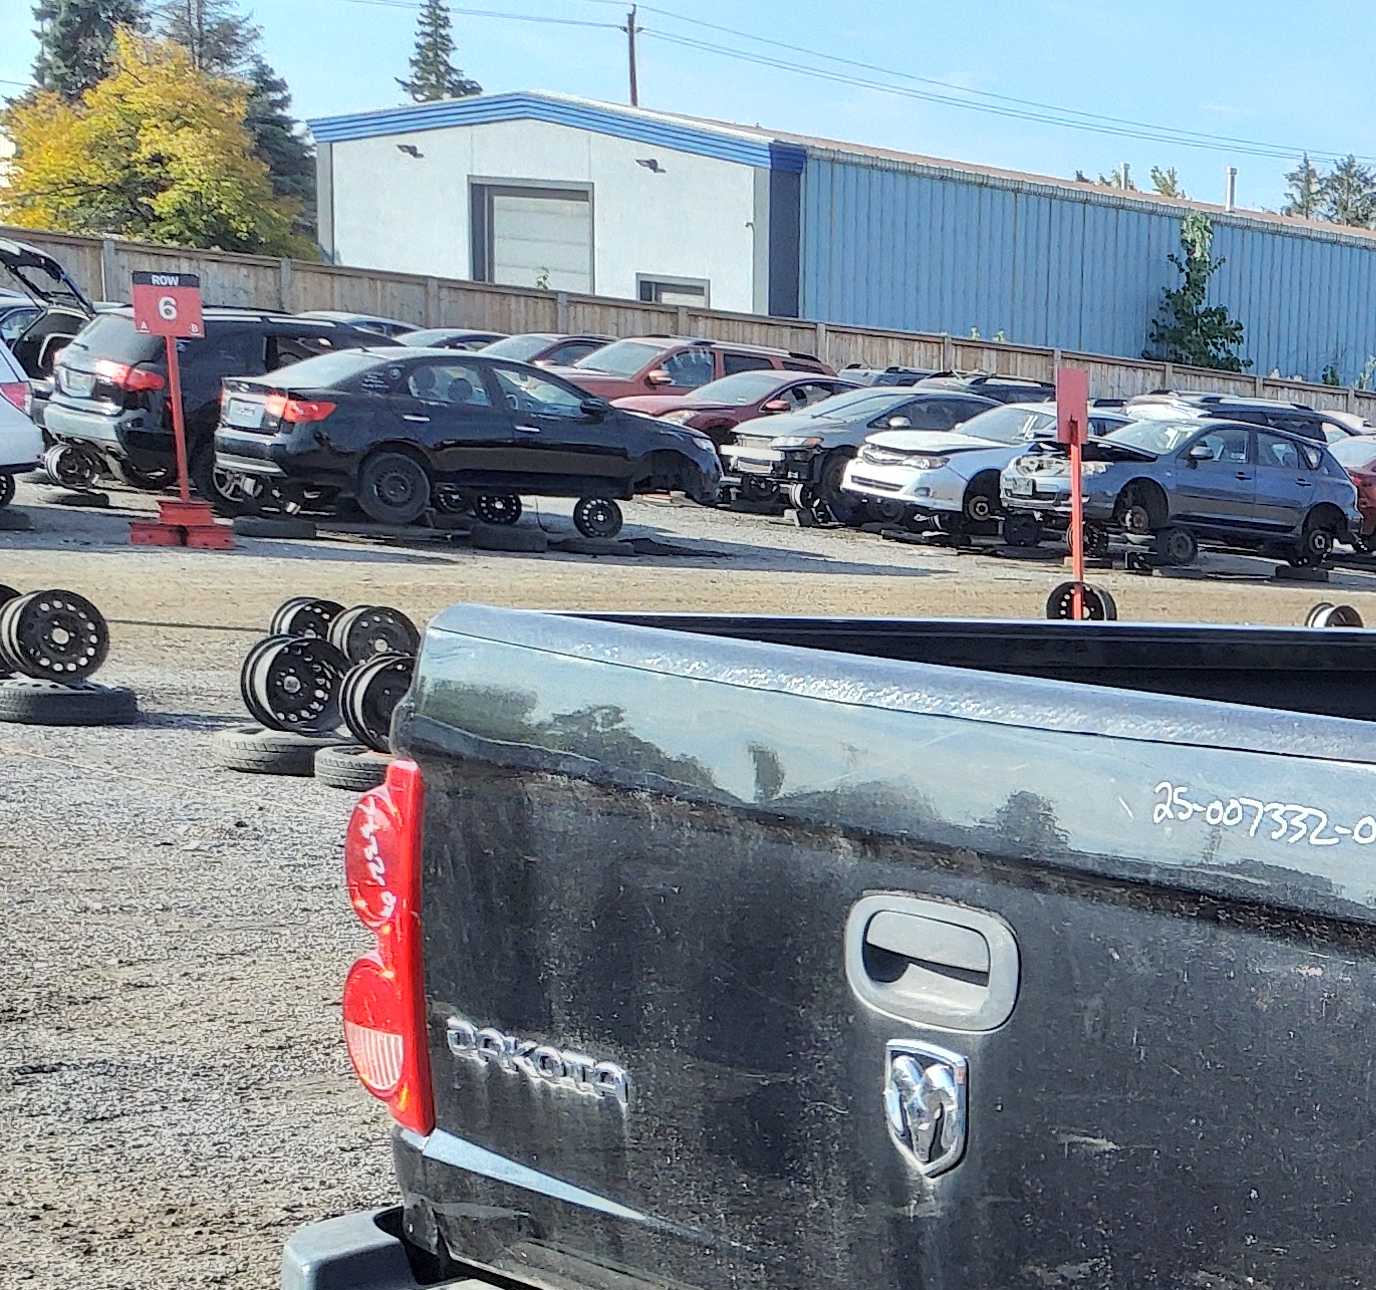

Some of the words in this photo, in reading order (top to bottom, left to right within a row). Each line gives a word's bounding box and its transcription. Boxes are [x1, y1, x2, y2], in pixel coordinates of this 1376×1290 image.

[151, 274, 179, 286] ROW
[158, 296, 177, 321] 6
[140, 320, 149, 330] A
[446, 1016, 630, 1106] DAKOTA
